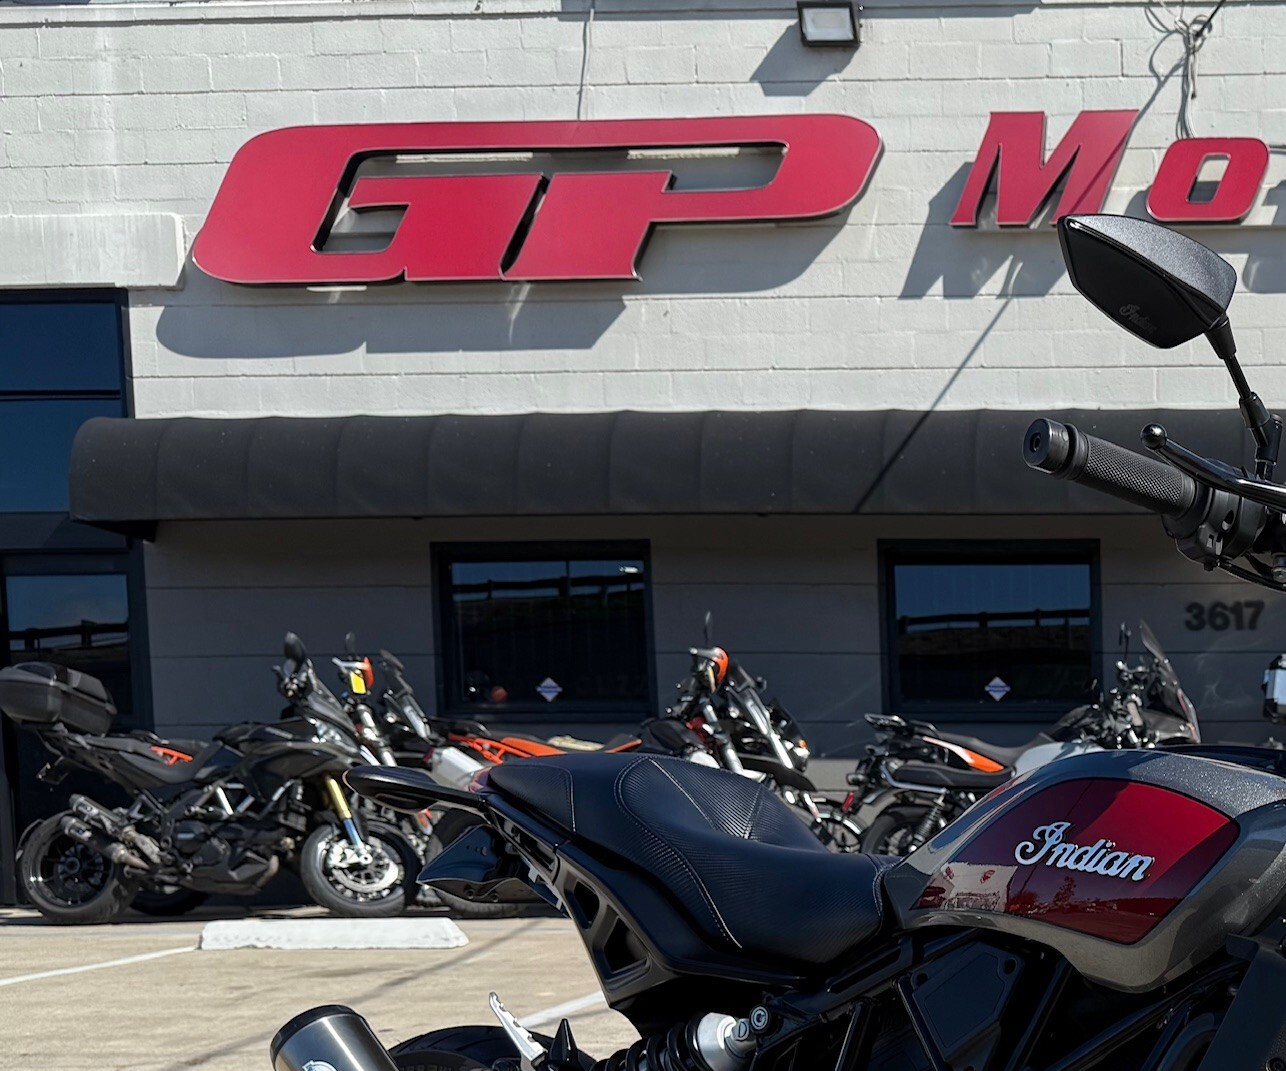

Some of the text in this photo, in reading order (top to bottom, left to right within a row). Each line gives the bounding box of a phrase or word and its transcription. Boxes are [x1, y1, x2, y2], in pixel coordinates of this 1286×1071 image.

[192, 113, 884, 286] GP
[1184, 601, 1265, 631] 3617
[1014, 821, 1155, 881] Indian
